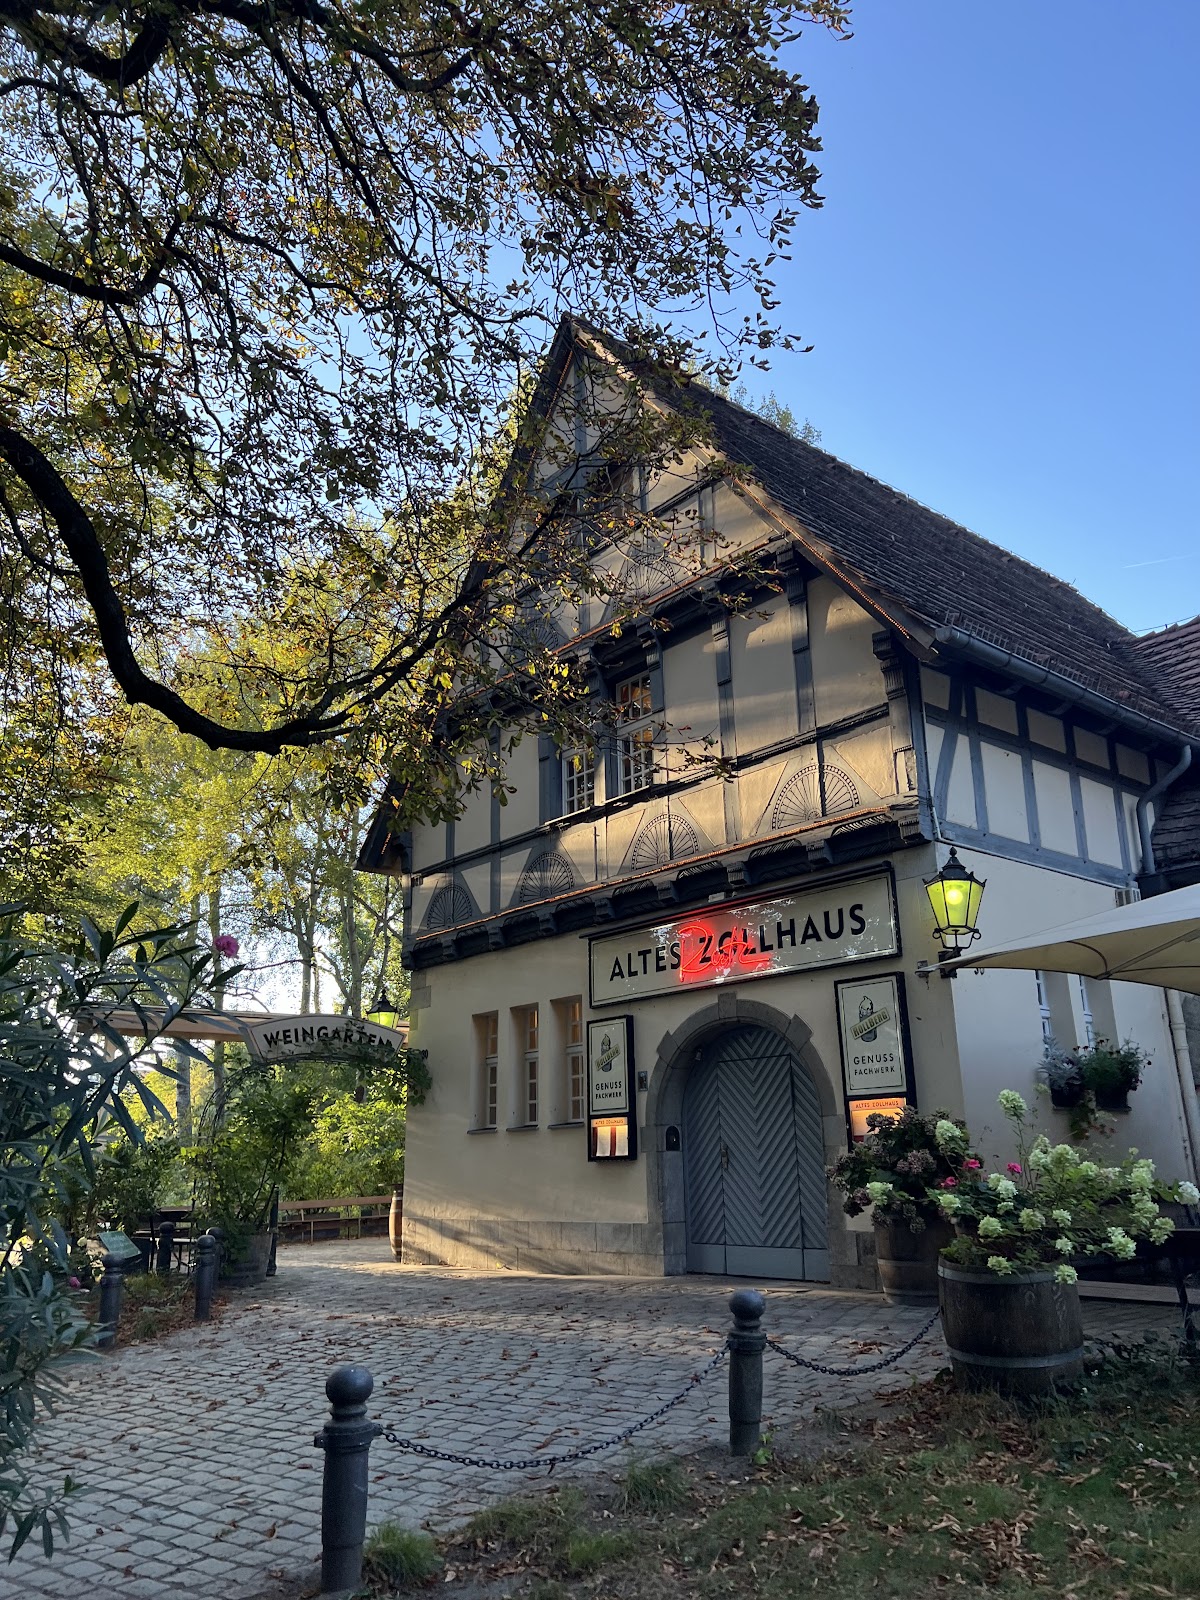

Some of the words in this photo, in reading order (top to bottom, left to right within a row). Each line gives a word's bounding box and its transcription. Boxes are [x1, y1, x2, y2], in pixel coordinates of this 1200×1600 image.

[609, 942, 681, 982] ALTES
[698, 903, 867, 965] ZOLLHAUS
[853, 1053, 894, 1065] GENUSS
[854, 1065, 895, 1076] FACHWERK
[595, 1080, 622, 1091] GENUSS
[595, 1091, 623, 1100] FACHWERK
